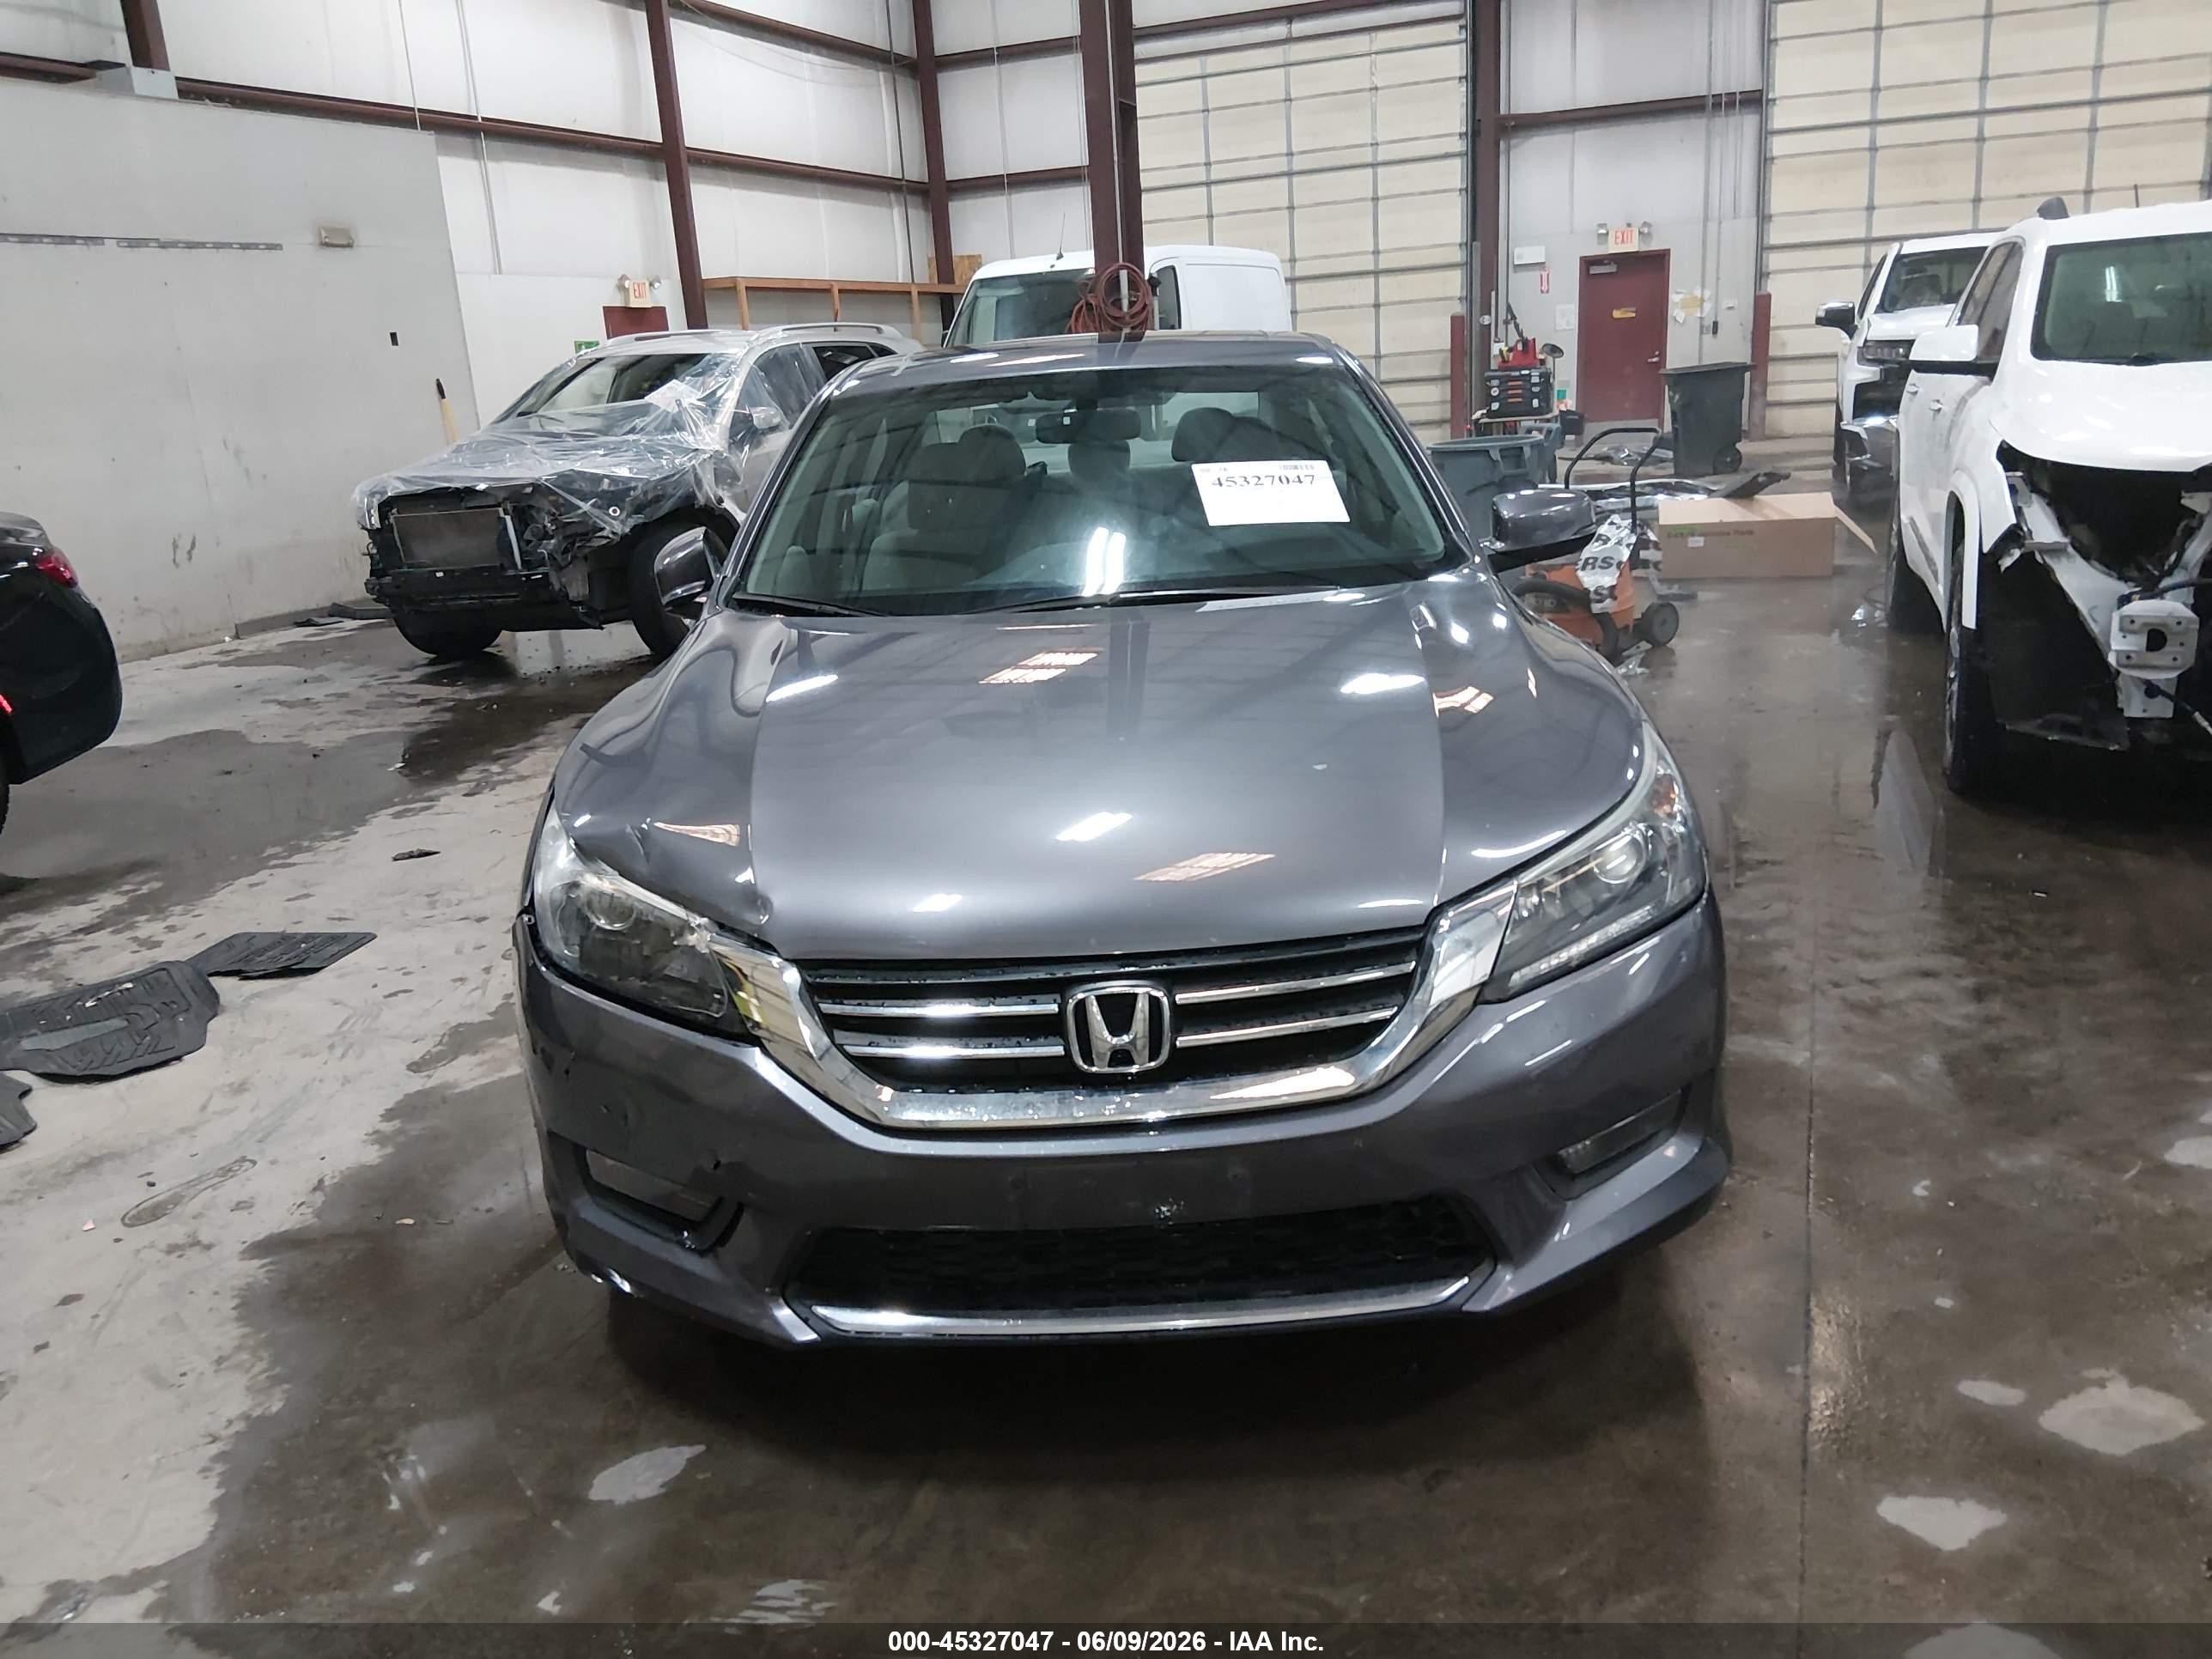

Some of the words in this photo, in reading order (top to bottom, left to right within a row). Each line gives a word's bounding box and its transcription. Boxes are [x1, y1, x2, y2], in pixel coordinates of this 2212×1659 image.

[1613, 229, 1635, 245] EXIT
[632, 282, 647, 299] EXIT
[1212, 474, 1316, 488] 45327047
